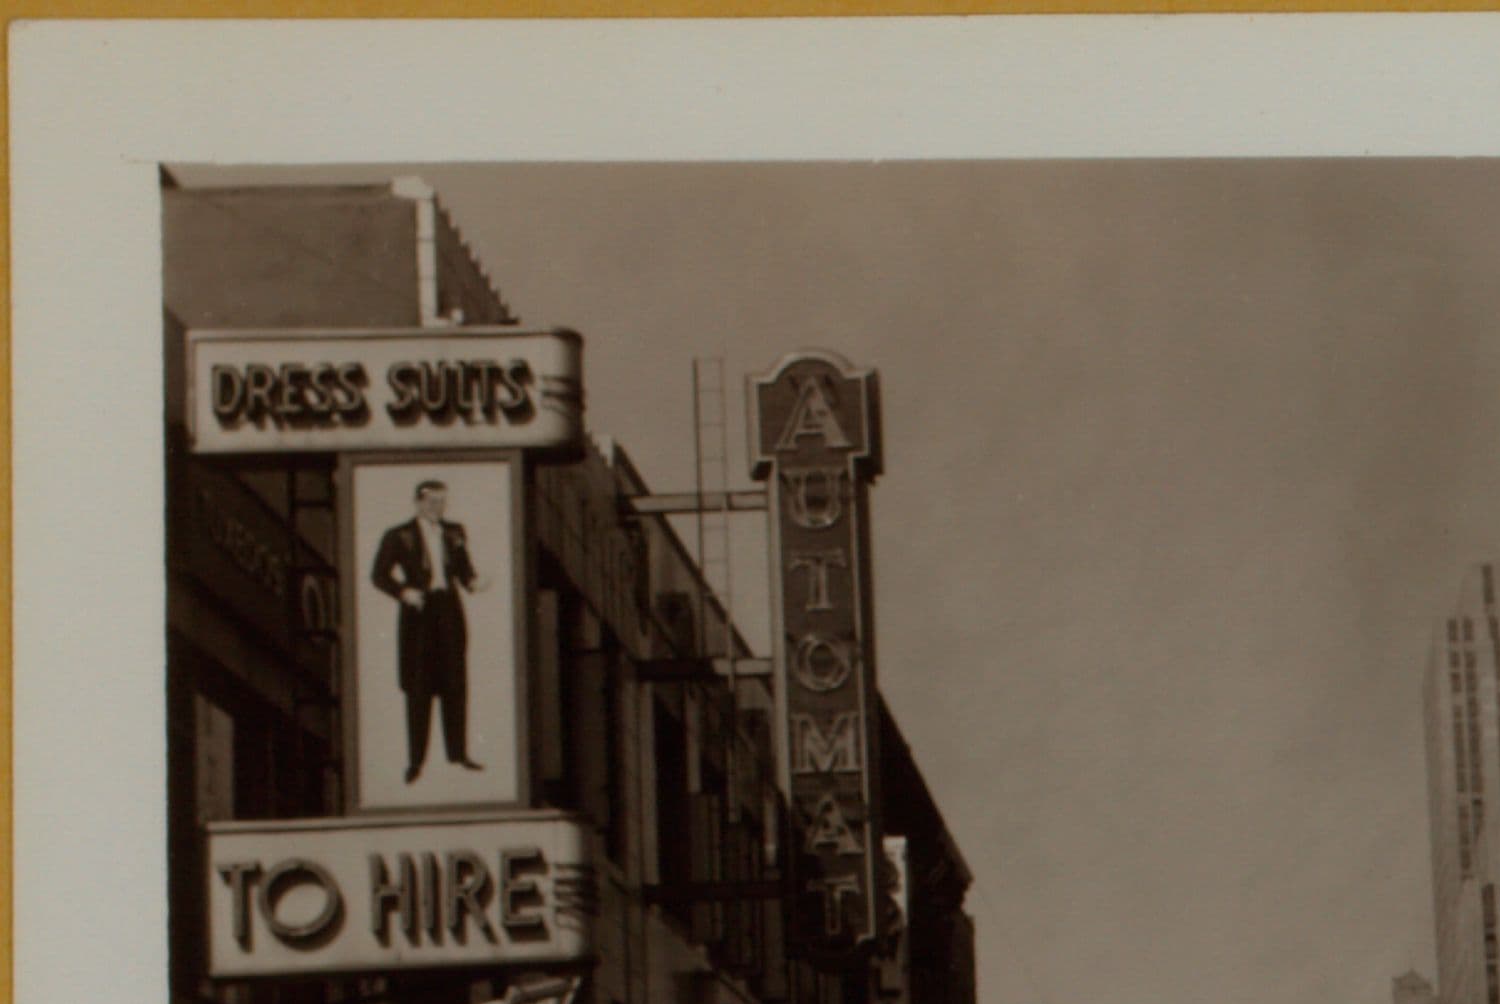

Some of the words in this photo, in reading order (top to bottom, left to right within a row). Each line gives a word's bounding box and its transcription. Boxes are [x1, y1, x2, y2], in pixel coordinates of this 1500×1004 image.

[211, 362, 371, 430] DRESS
[386, 360, 536, 427] SUITS
[774, 376, 865, 937] AUTOMAT
[214, 857, 347, 955] TO
[368, 846, 552, 949] HIRE
